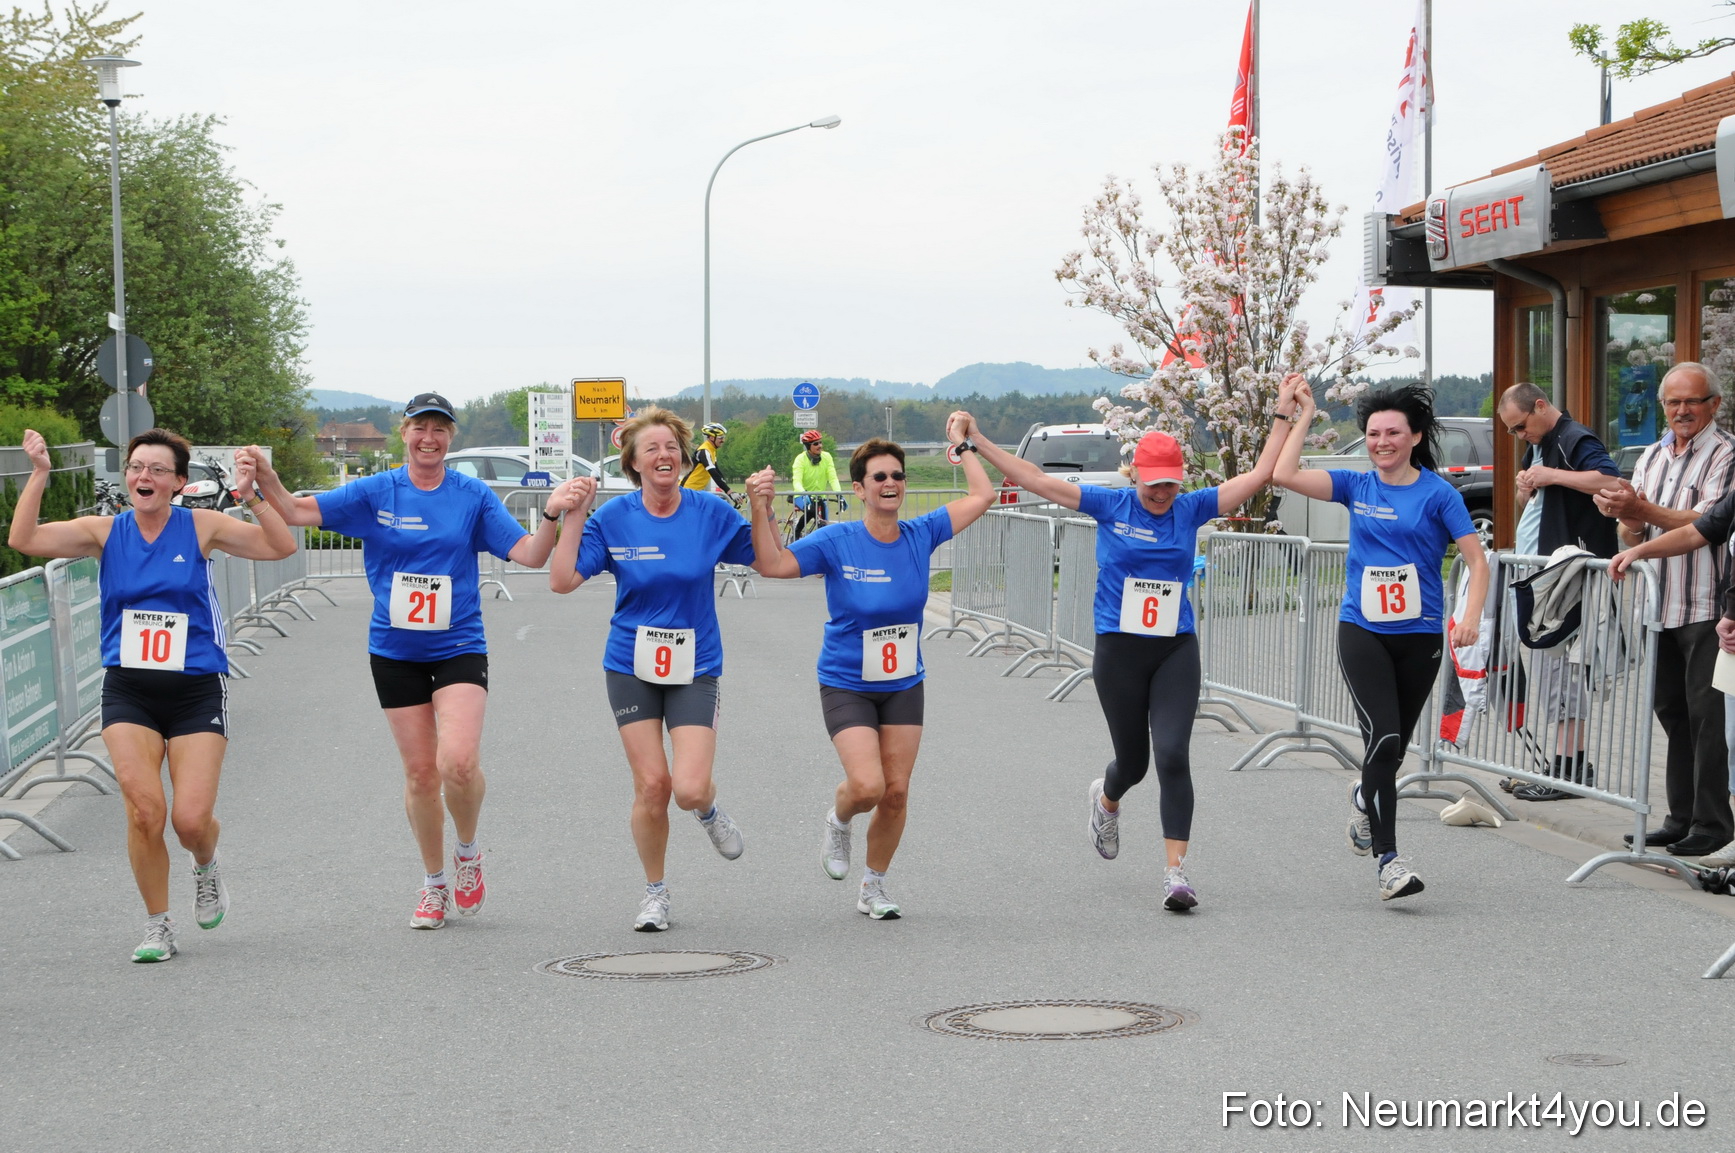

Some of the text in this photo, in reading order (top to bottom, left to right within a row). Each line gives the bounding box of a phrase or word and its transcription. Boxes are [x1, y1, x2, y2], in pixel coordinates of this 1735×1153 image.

[1460, 194, 1524, 238] SEAT
[579, 395, 620, 404] Neumarkt
[539, 447, 553, 456] THULE
[526, 478, 547, 486] VOLVO
[402, 576, 428, 584] MEYER
[1377, 583, 1406, 614] 13
[408, 591, 436, 624] 21
[1142, 597, 1158, 628] 6
[133, 613, 163, 621] MEYER
[647, 630, 674, 639] MEYER
[872, 628, 896, 637] MEYER
[140, 629, 171, 662] 10
[655, 646, 671, 677] 9
[882, 642, 897, 673] 8
[615, 705, 638, 718] ODLO
